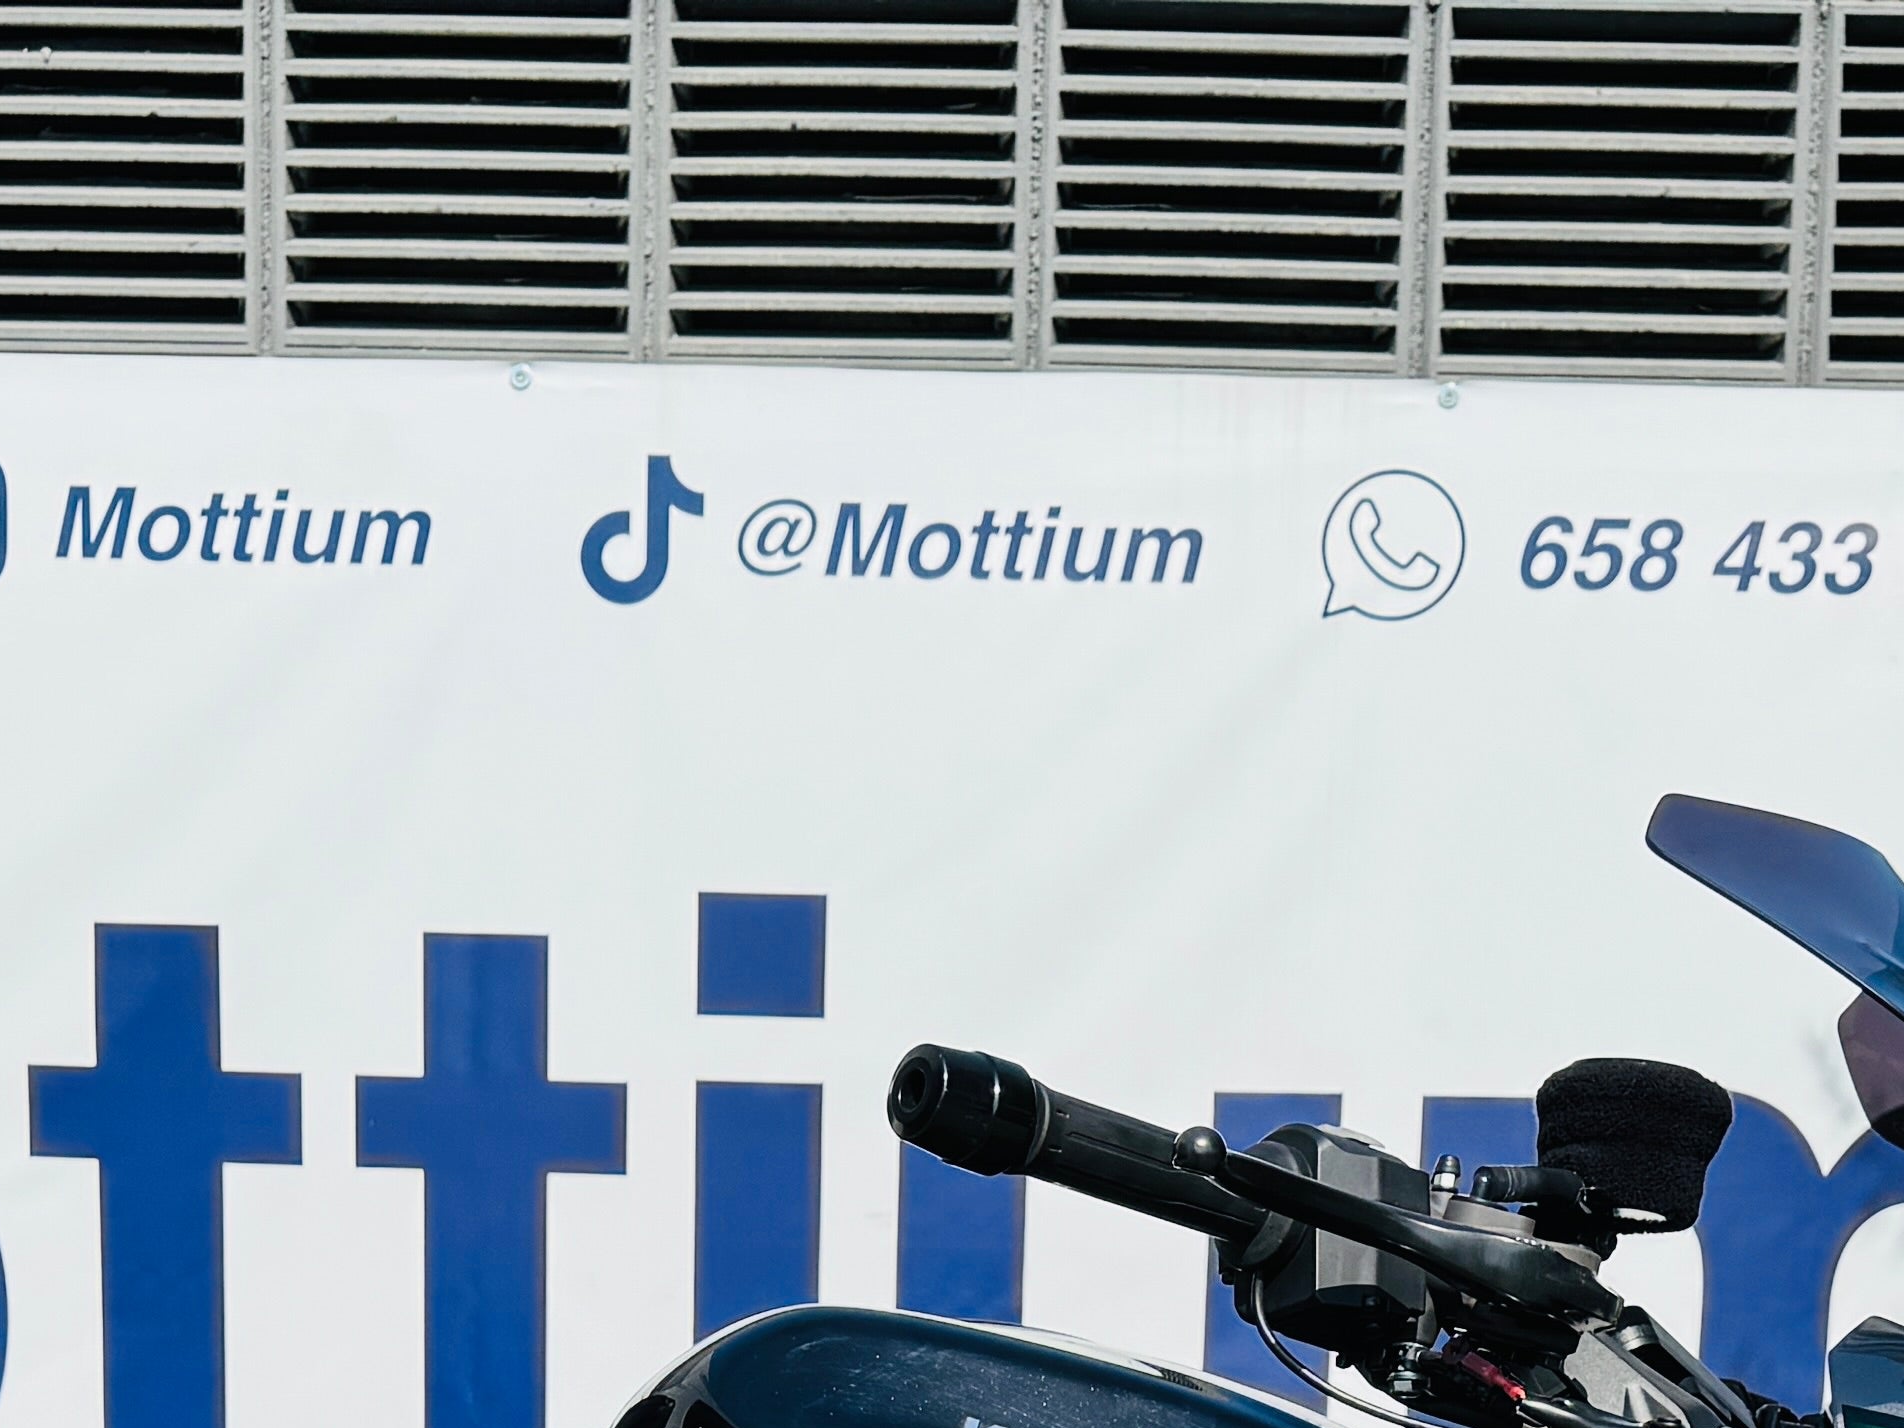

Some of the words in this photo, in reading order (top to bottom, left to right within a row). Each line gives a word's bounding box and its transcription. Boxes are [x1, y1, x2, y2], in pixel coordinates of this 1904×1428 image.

[55, 486, 432, 565] Mottium
[737, 498, 1203, 584] @Mottium
[1520, 515, 1684, 592] 658
[1712, 521, 1879, 596] 433
